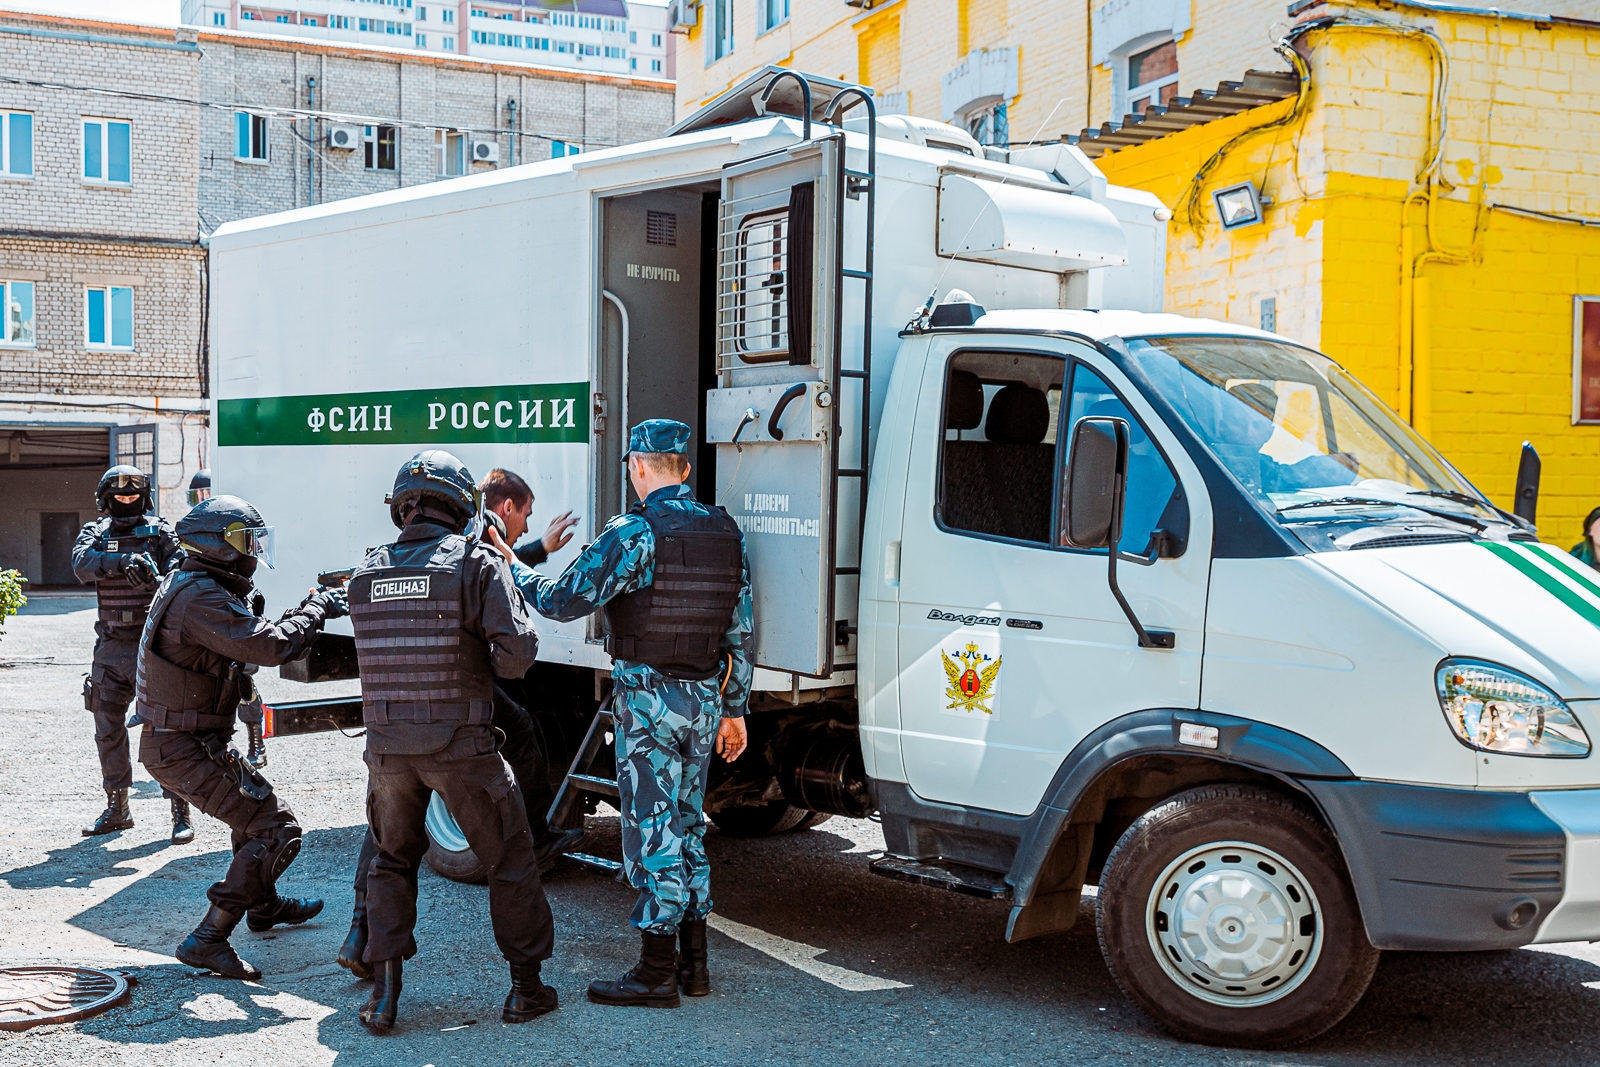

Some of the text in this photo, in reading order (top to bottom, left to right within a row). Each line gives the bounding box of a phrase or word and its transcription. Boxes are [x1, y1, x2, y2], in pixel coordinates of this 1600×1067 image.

[626, 263, 680, 282] НЕ КУРИТЬ
[307, 398, 576, 433] ФСИН РОССИИ
[744, 493, 789, 514] К ДВЕРИ
[373, 580, 426, 597] СПЕЦНАЗ
[927, 608, 1001, 627] Валдай
